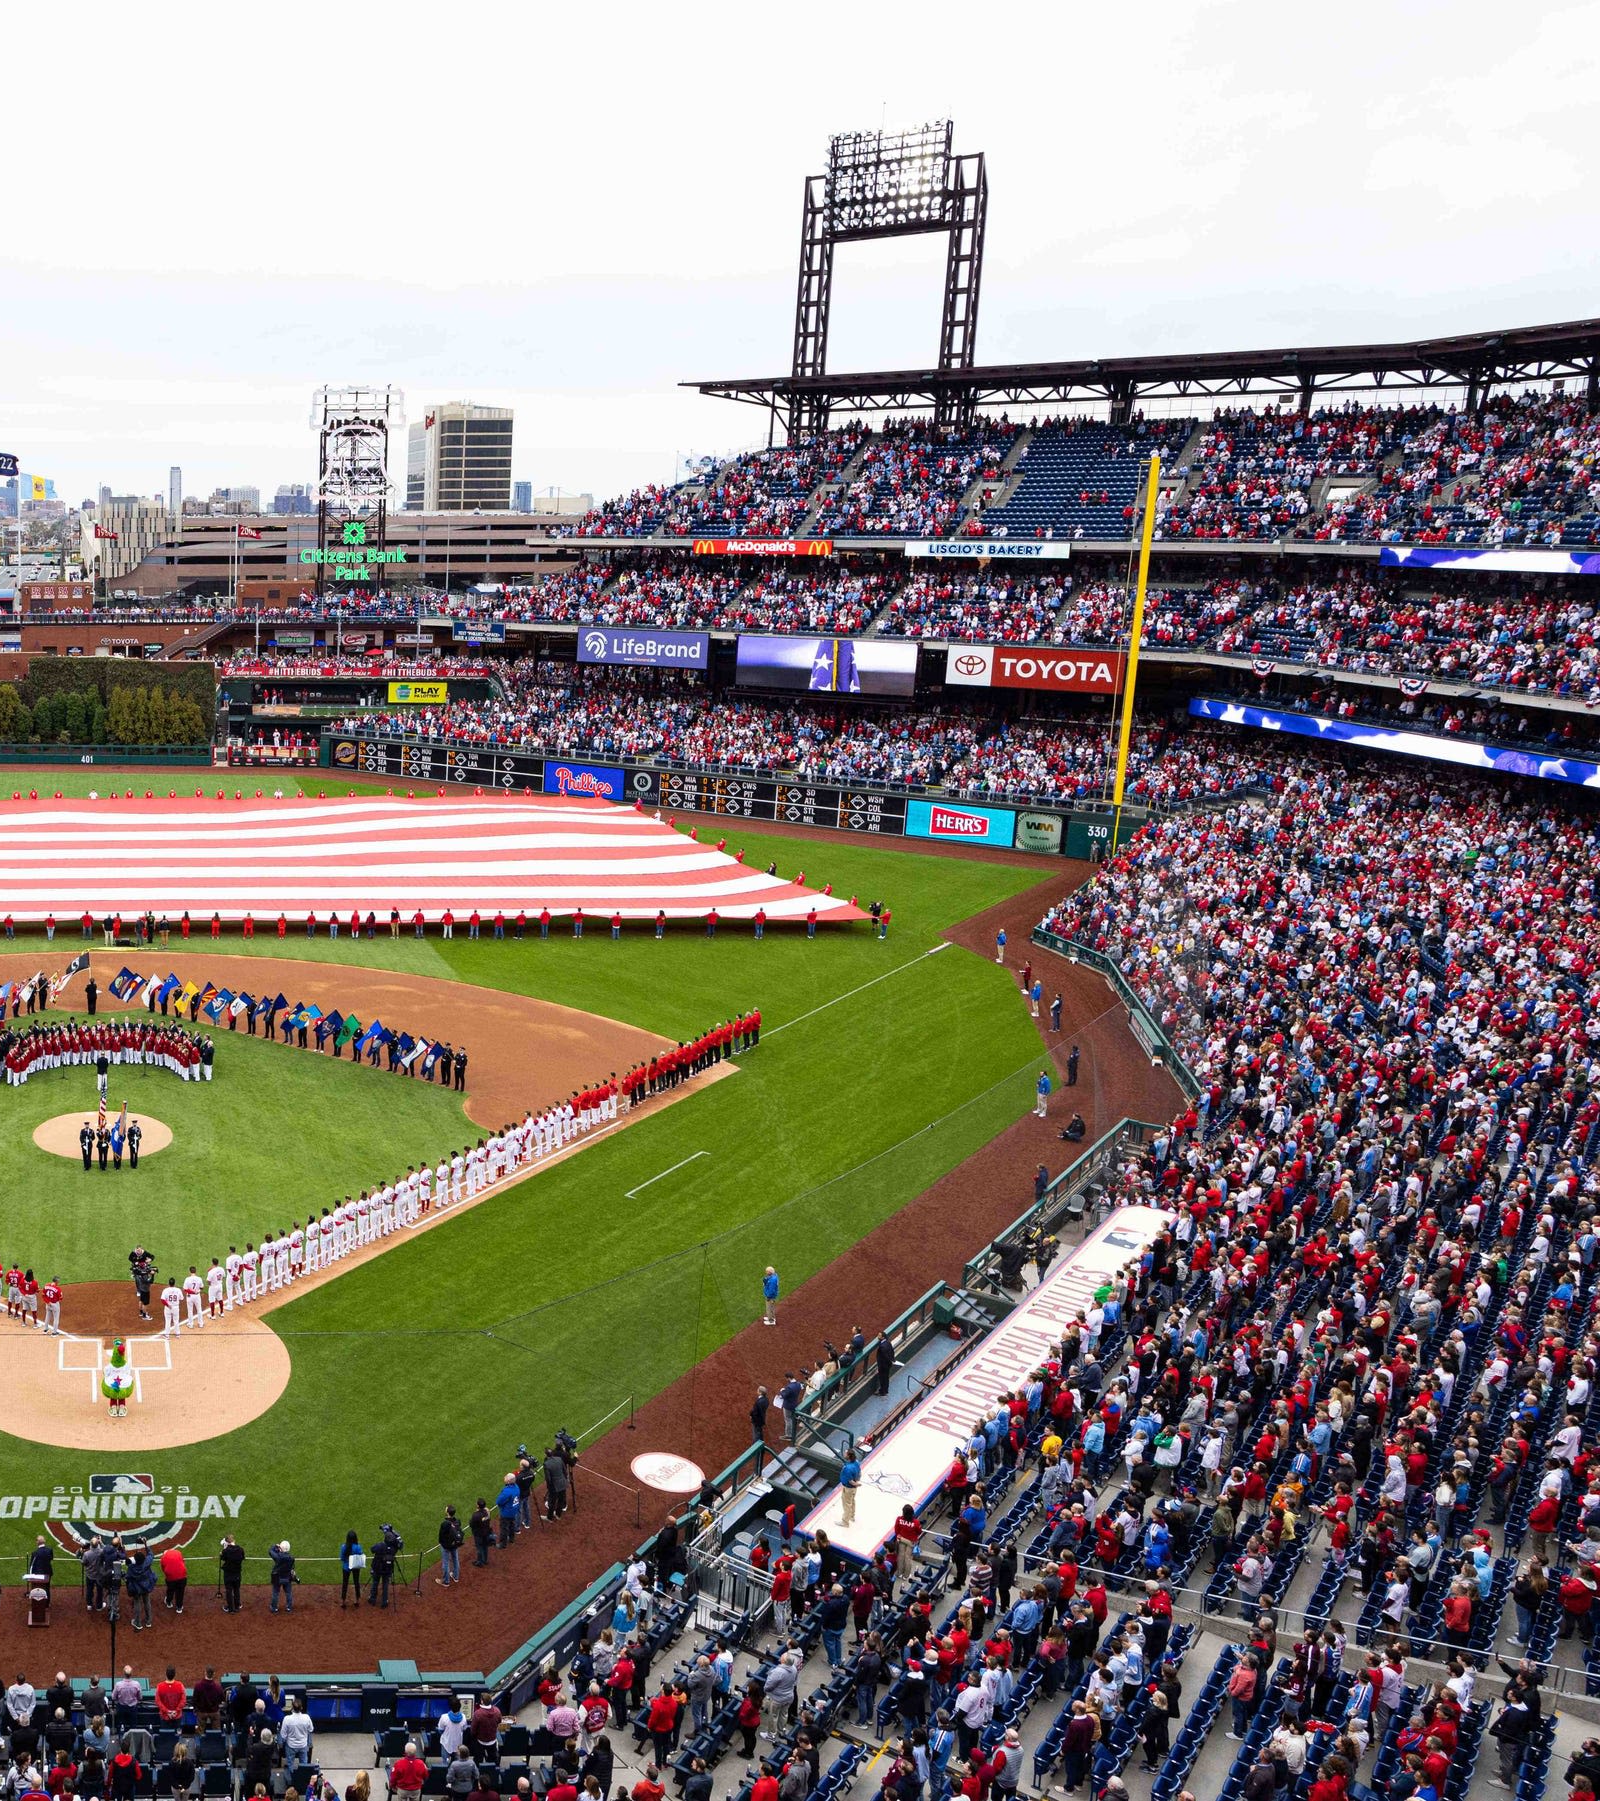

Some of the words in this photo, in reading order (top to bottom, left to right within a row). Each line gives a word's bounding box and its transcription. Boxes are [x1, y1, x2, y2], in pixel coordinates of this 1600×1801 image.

[726, 541, 796, 551] McDonald's
[929, 544, 984, 554] LISCIO'S
[988, 545, 1043, 555] BAKERY
[300, 548, 363, 564] Citizens
[367, 547, 406, 563] Bank
[335, 566, 370, 581] Park
[612, 638, 701, 659] LifeBrand
[268, 667, 322, 676] #HITTHEBUDS
[382, 667, 437, 676] #HITTHEBUDS
[999, 657, 1113, 684] TOYOTA
[80, 755, 94, 764] 401
[555, 767, 613, 795] Phillies
[742, 782, 757, 790] CWS
[685, 793, 696, 801] TEX
[743, 790, 754, 798] PIT
[743, 800, 753, 808] KC
[804, 797, 816, 805] ATL
[867, 795, 884, 804] WSH
[683, 801, 696, 809] CHC
[868, 804, 882, 813] COL
[743, 808, 752, 816] SF
[803, 807, 815, 815] STL
[803, 815, 815, 823] MIL
[867, 814, 881, 822] LAD
[934, 813, 983, 832] HERR'S
[867, 823, 880, 832] ARI
[1025, 820, 1055, 832] WM
[1087, 825, 1108, 838] 330
[1027, 1265, 1113, 1325] PHILLIES
[917, 1326, 1059, 1441] PHILADELPHIA
[175, 1495, 247, 1519] DAY
